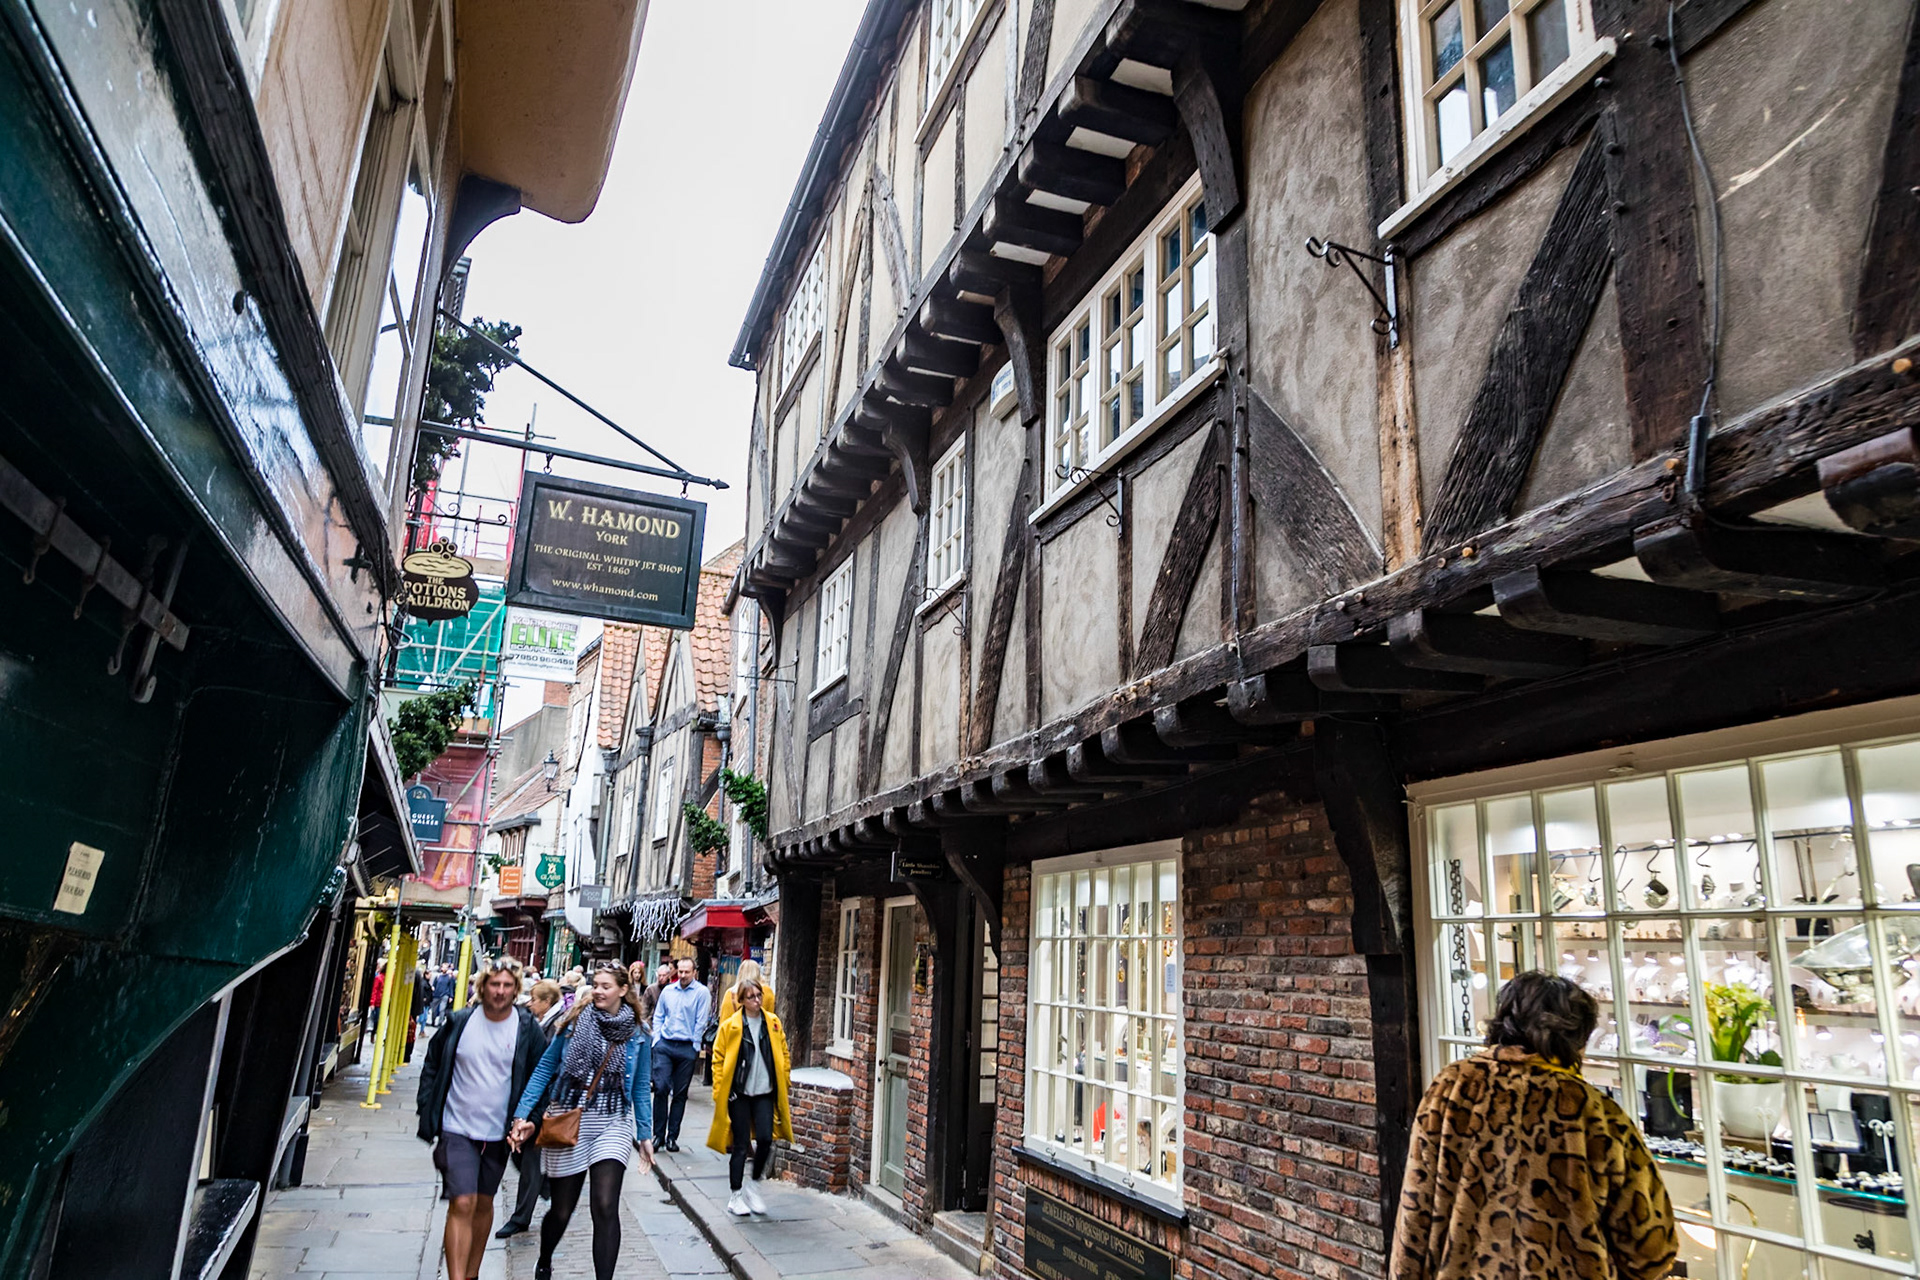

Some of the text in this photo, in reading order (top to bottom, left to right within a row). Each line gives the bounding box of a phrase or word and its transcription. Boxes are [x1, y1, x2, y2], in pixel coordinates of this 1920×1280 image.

[548, 499, 681, 539] W. HAMOND
[596, 530, 629, 546] YORK
[534, 543, 683, 575] THE ORIGINAL WHITBY JET SHOP
[586, 562, 630, 576] EST. 1860
[426, 576, 445, 585] THE
[552, 578, 659, 601] www.whamond.com
[403, 581, 467, 599] POTIONS
[396, 593, 471, 612] CAULDRON
[513, 616, 578, 633] YORKSHIRE
[511, 623, 577, 651] ELITE
[411, 818, 439, 826] WALKER
[1042, 1200, 1145, 1265] JEWELLERS WORKSHOP UPSTAIRS
